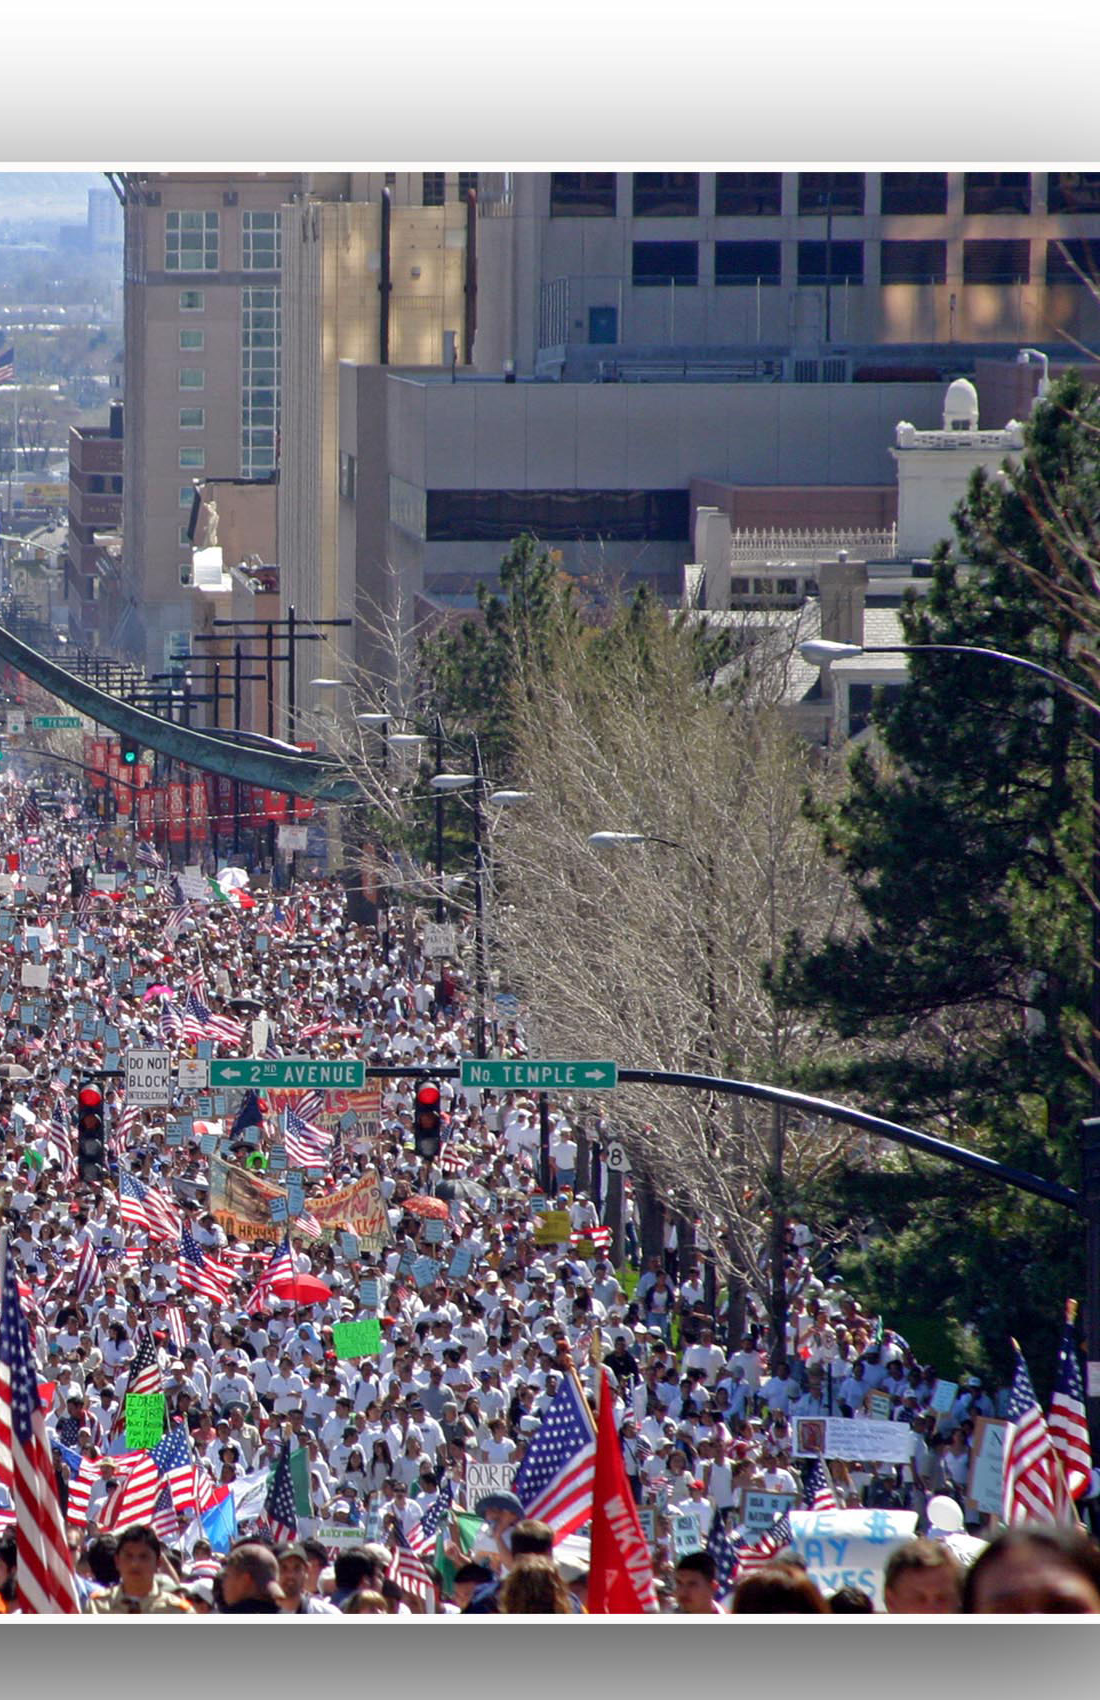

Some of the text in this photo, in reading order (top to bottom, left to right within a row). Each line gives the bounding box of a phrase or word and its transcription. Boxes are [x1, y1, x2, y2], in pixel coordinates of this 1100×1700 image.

[130, 1057, 168, 1070] DO NOT
[129, 1075, 170, 1088] BLOCK
[250, 1065, 356, 1083] 2ND AVENUE
[502, 1066, 577, 1083] TEMPLE
[610, 1148, 623, 1166] 8
[467, 1464, 500, 1487] OUR
